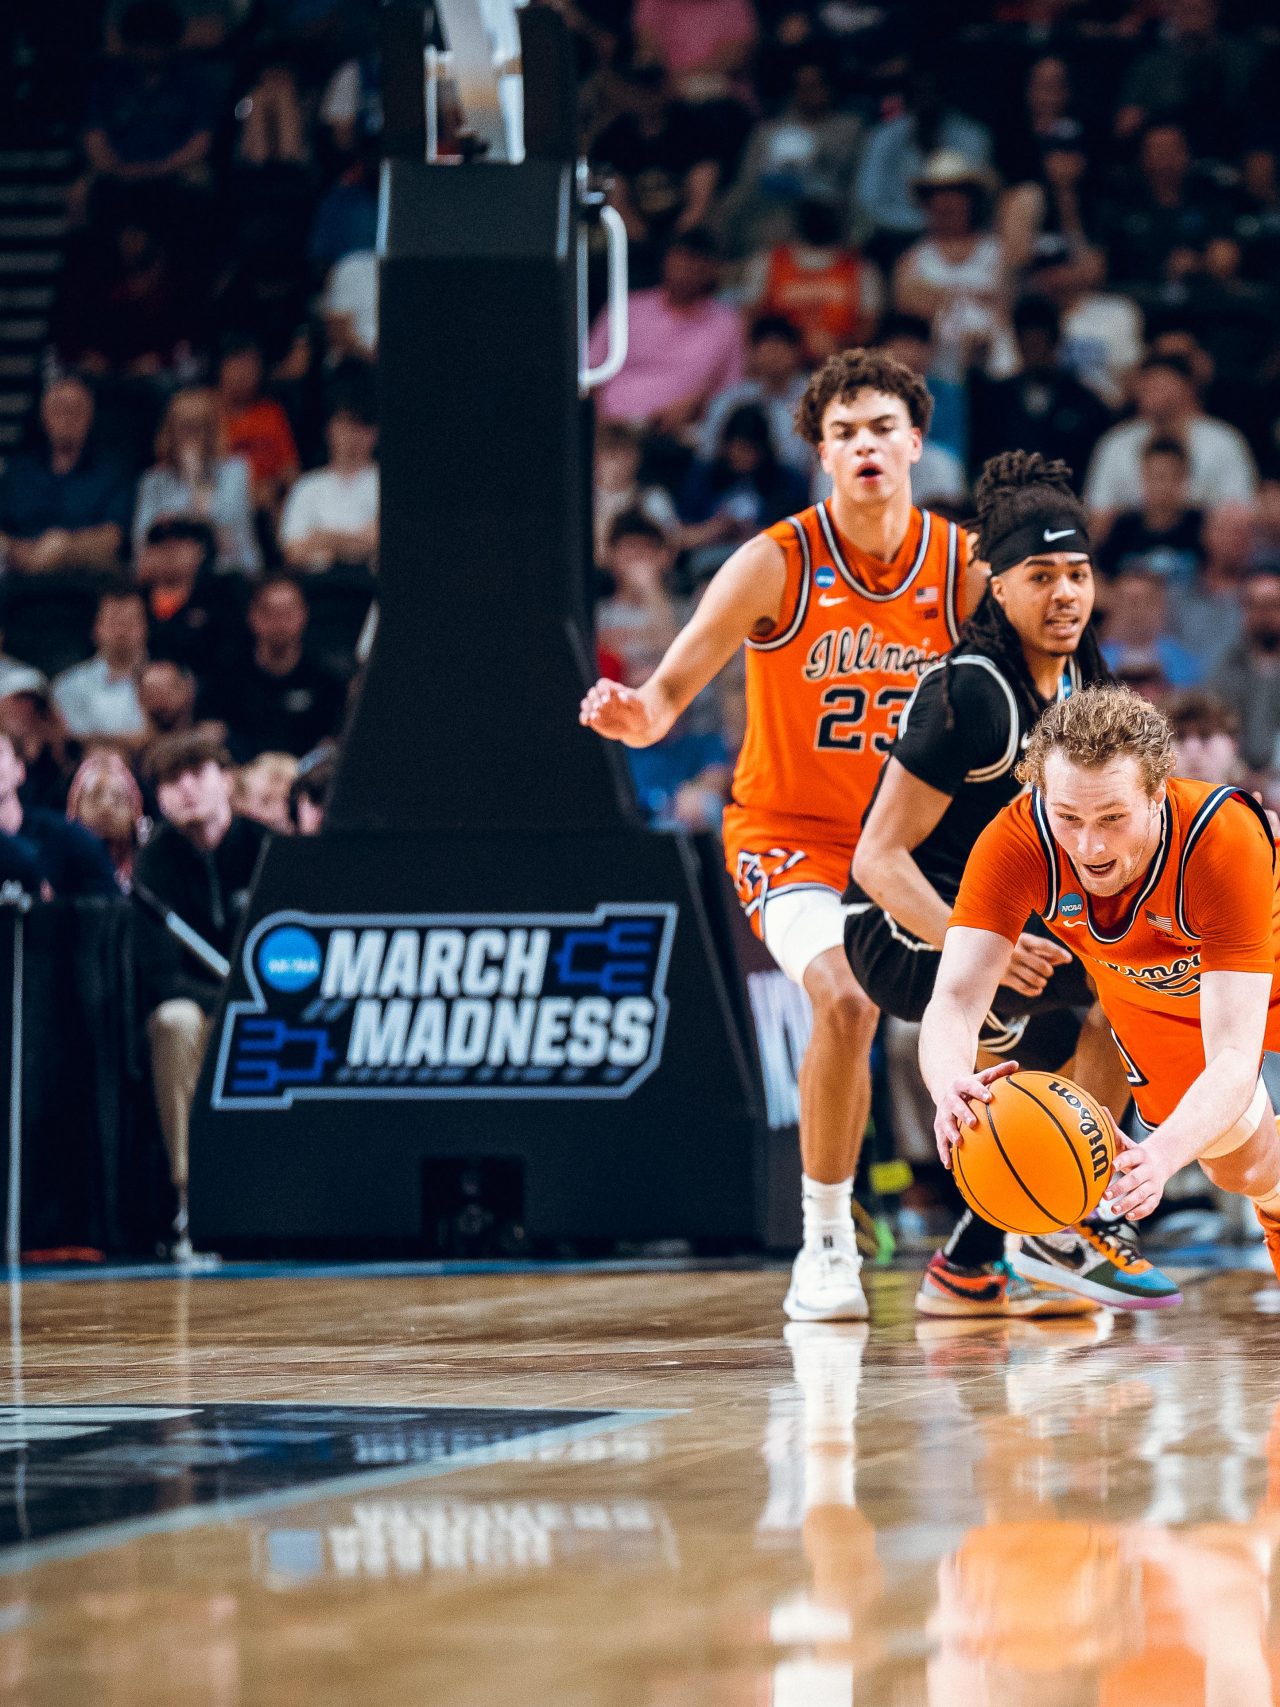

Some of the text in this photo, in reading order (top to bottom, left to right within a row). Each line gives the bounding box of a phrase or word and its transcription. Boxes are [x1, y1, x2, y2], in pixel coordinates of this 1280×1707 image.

[802, 622, 940, 684] Illinoi
[1061, 903, 1083, 913] NCAA
[320, 928, 552, 998] MARCH
[346, 998, 655, 1067] MADNESS
[1047, 1080, 1110, 1183] Wilson
